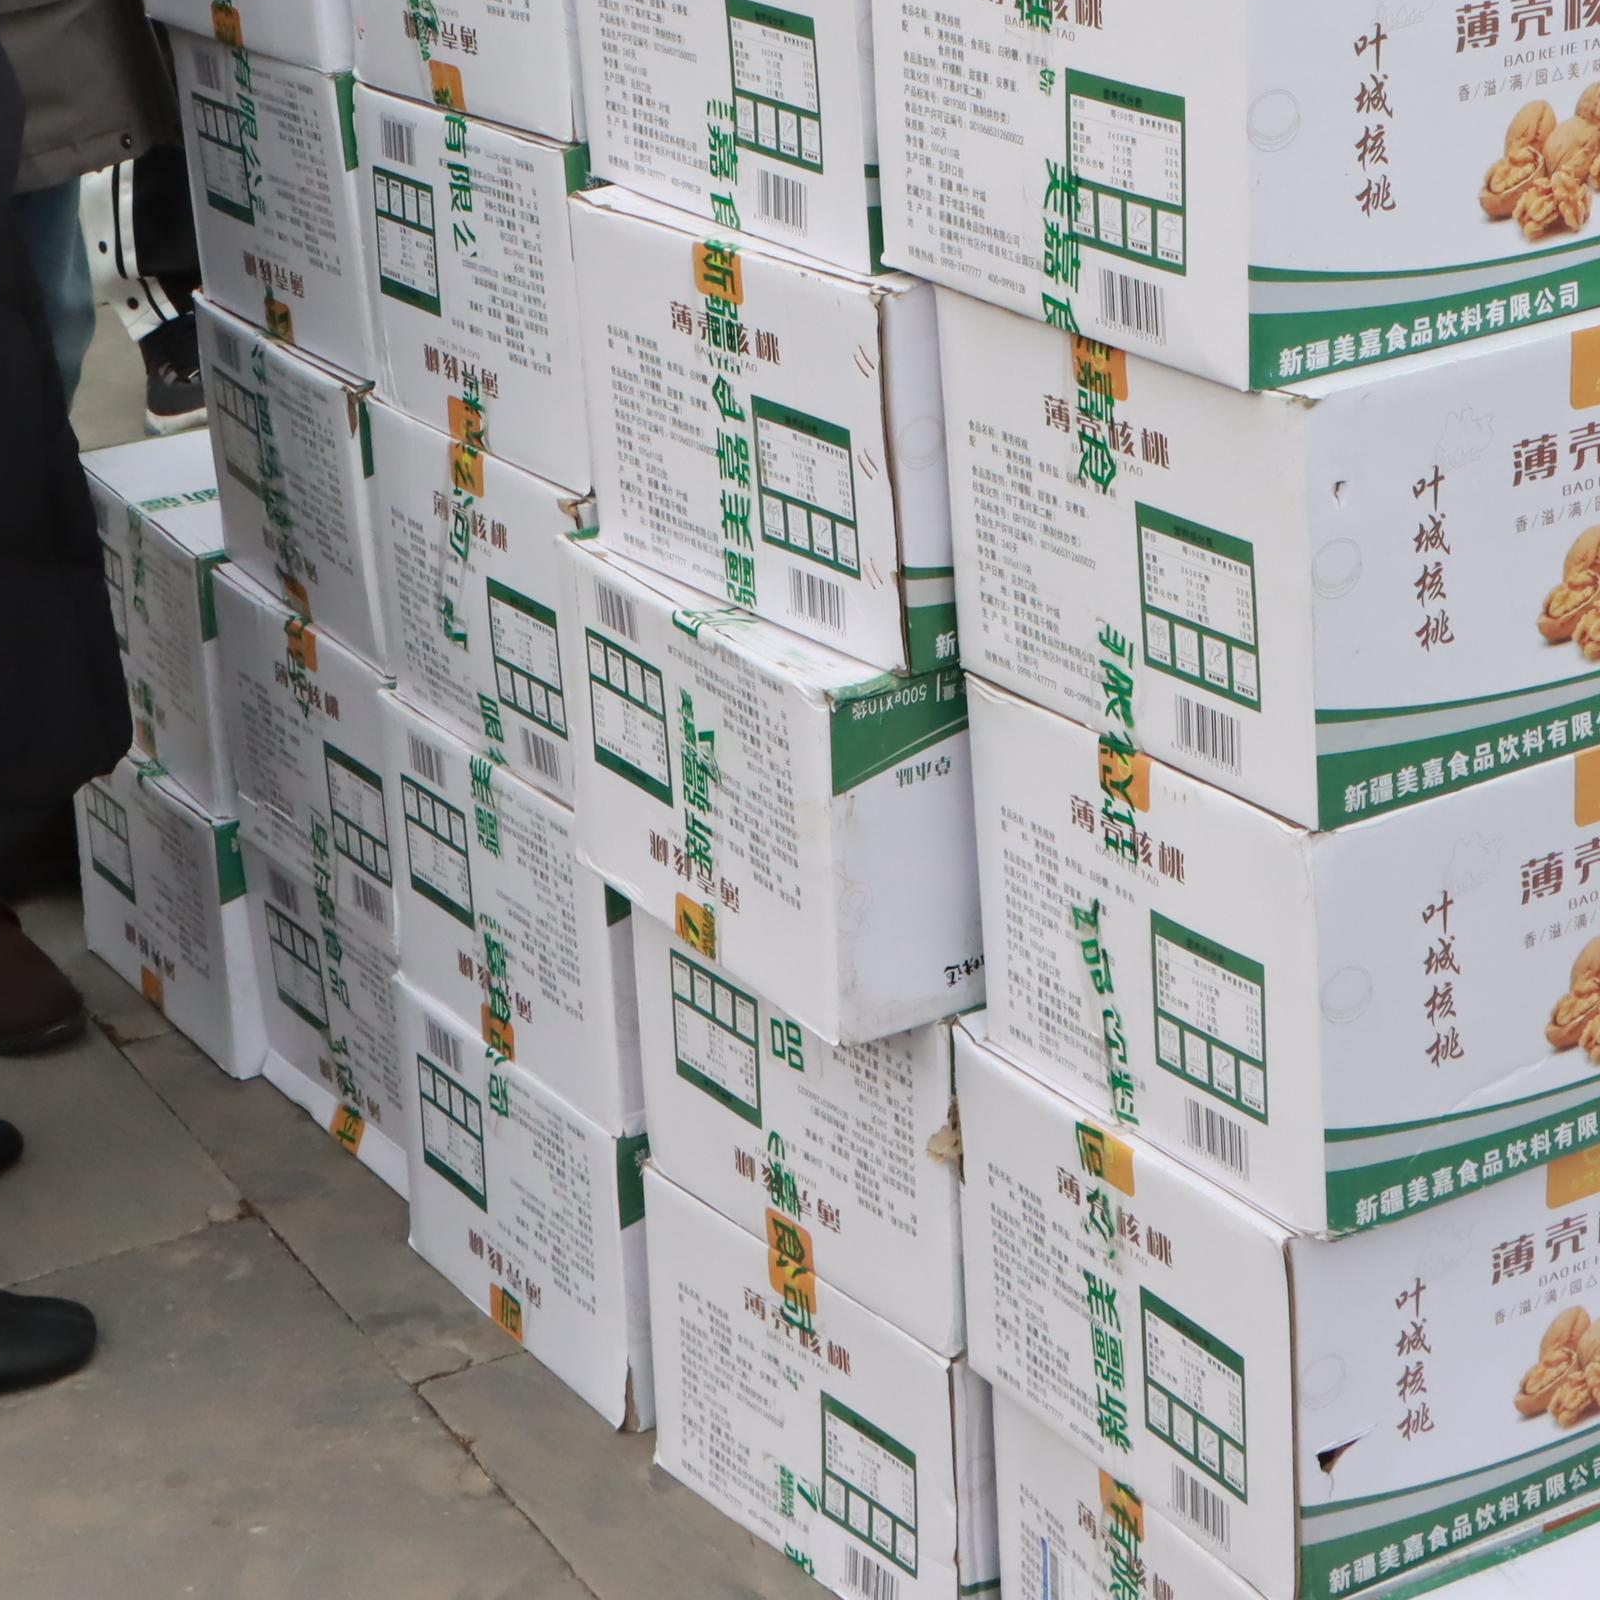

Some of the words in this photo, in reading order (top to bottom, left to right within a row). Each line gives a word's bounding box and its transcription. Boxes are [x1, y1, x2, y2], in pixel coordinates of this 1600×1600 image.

[1504, 51, 1535, 67] BAO
[1539, 48, 1557, 63] KE
[1560, 45, 1580, 60] HE
[1353, 23, 1396, 216] 叶城核桃
[1278, 282, 1580, 378] 新疆美嘉食品饮料有限公司
[1562, 477, 1593, 495] BAO
[1411, 466, 1455, 649] 叶城核桃
[1569, 891, 1598, 910] BAO
[1421, 891, 1464, 1068] 叶城核桃
[1538, 1272, 1570, 1288] BAO
[1573, 1264, 1591, 1279] KE
[1395, 1278, 1434, 1442] 叶城核桃
